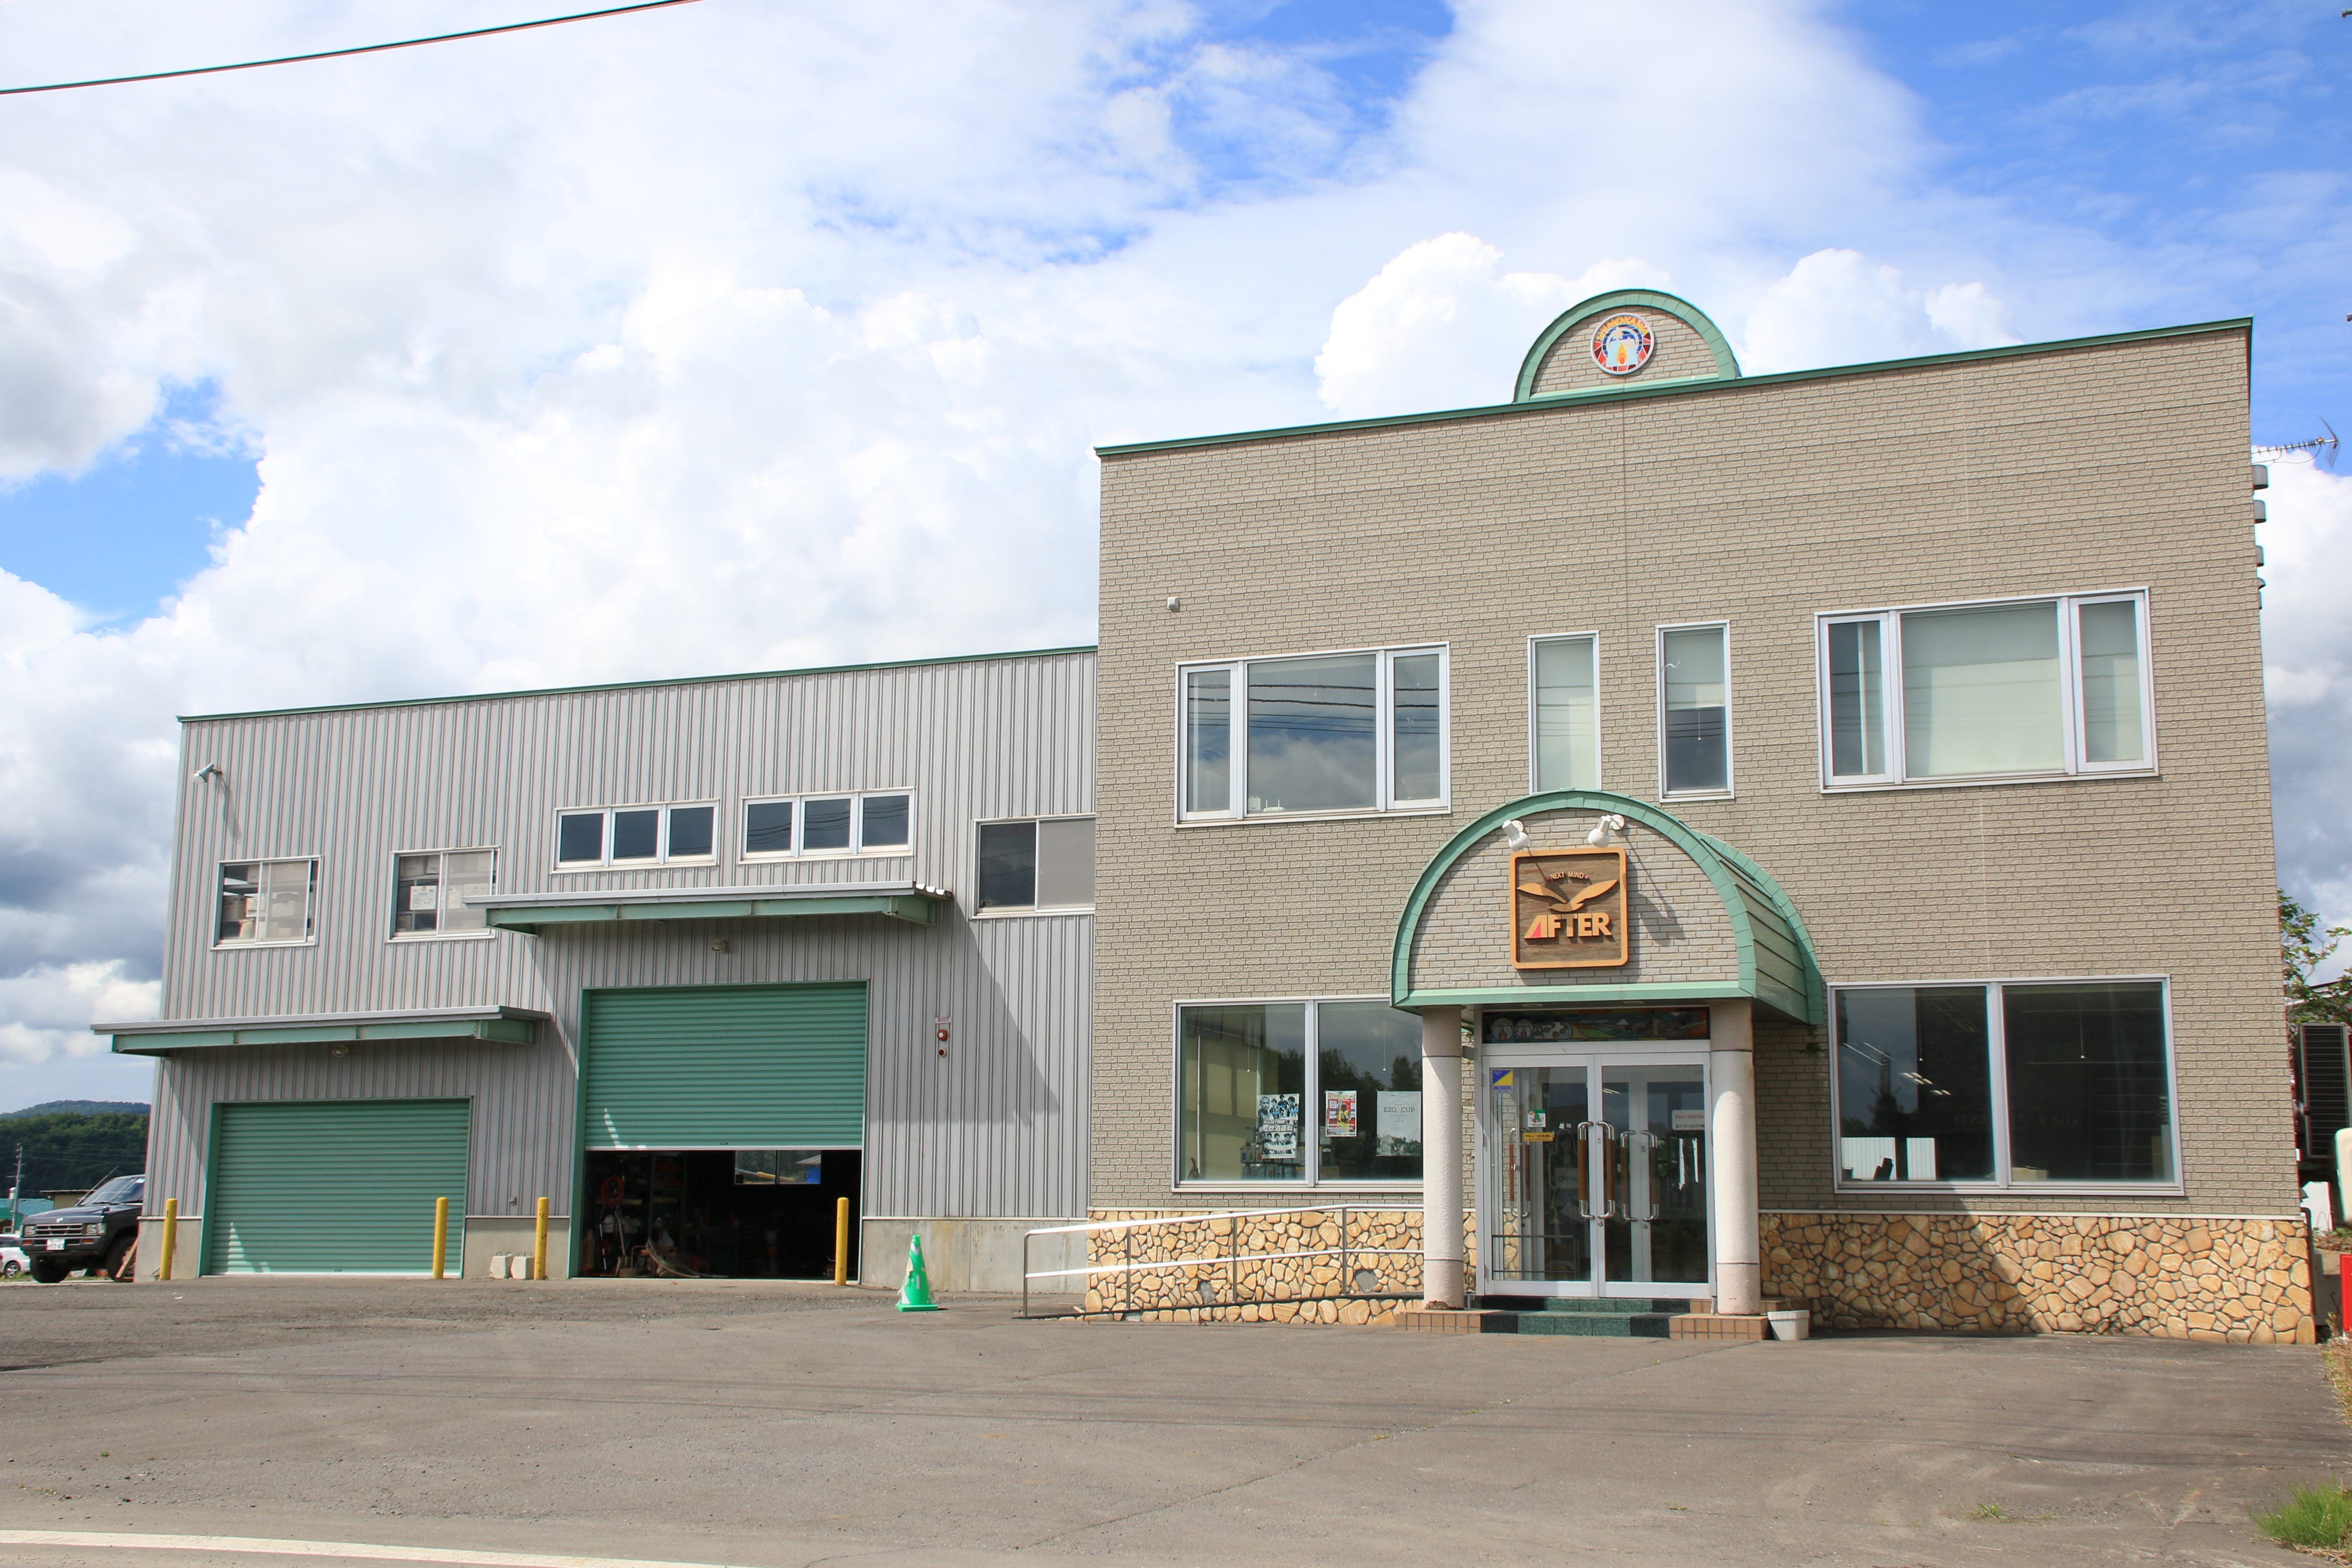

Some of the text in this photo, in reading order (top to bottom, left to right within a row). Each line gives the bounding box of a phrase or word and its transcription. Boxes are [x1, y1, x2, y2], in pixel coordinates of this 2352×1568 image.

[1596, 316, 1649, 340] SHIMOKAWA
[1524, 913, 1612, 939] AFTER
[1268, 1124, 1294, 1132] 飲酒運転
